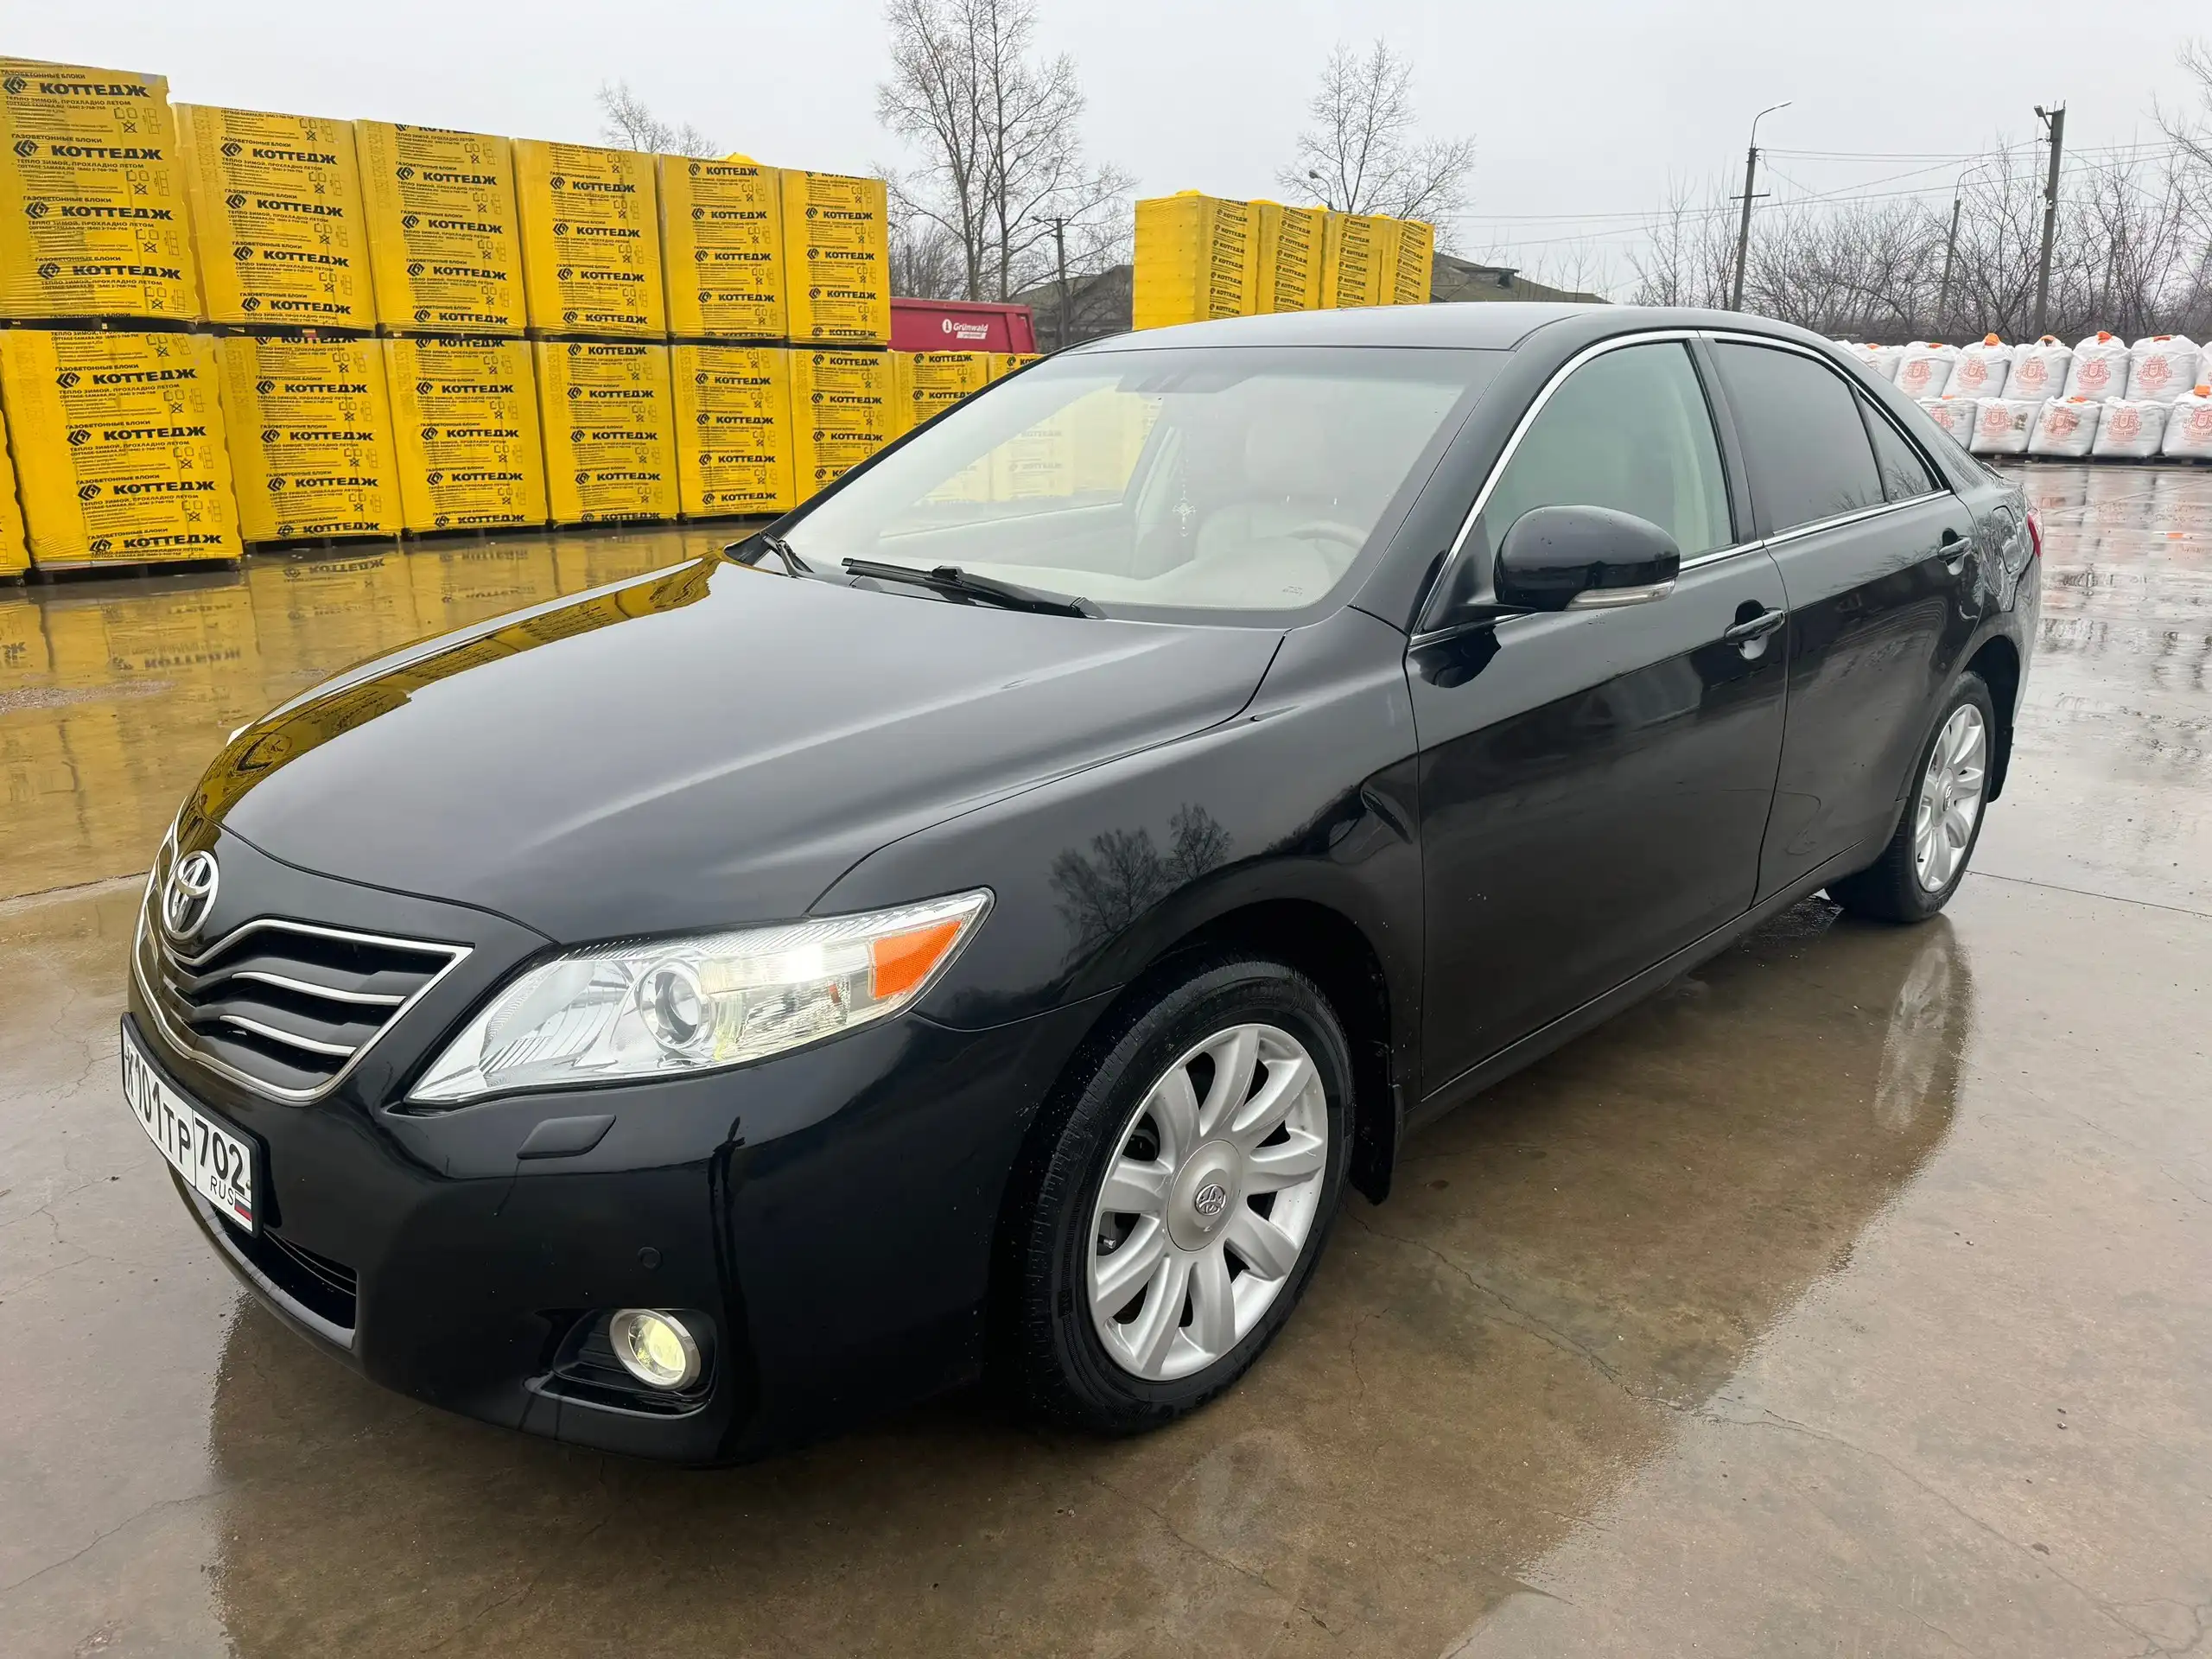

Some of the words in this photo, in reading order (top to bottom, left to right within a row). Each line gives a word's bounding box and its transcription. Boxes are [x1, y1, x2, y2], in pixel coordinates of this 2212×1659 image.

[40, 82, 150, 98] КОТТЕДЖ
[51, 144, 163, 161] КОТТЕДЖ
[252, 149, 338, 165] КОТТЕДЖ
[706, 166, 759, 176] КОТТЕДЖ
[423, 171, 497, 186] КОТТЕДЖ
[572, 181, 635, 193] КОТТЕДЖ
[61, 206, 174, 220] КОТТЕДЖ
[257, 199, 344, 218] КОТТЕДЖ
[711, 210, 767, 219] КОТТЕДЖ
[823, 211, 873, 220] КОТТЕДЖ
[428, 219, 503, 234] КОТТЕДЖ
[576, 226, 640, 238] КОТТЕДЖ
[263, 251, 349, 268] КОТТЕДЖ
[715, 251, 772, 261] КОТТЕДЖ
[825, 251, 874, 260] КОТТЕДЖ
[73, 266, 181, 280] КОТТЕДЖ
[433, 266, 506, 281] КОТТЕДЖ
[581, 270, 645, 282] КОТТЕДЖ
[718, 293, 775, 302] КОТТЕДЖ
[827, 290, 876, 300] КОТТЕДЖ
[270, 301, 351, 315] КОТТЕДЖ
[439, 312, 508, 325] КОТТЕДЖ
[585, 314, 648, 324] КОТТЕДЖ
[953, 322, 988, 332] Grünwald
[829, 328, 877, 338] КОТТЕДЖ
[588, 346, 647, 356] КОТТЕДЖ
[830, 357, 880, 366] КОТТЕДЖ
[929, 354, 973, 363] КОТТЕДЖ
[93, 368, 198, 385] КОТТЕДЖ
[714, 376, 771, 385] КОТТЕДЖ
[285, 384, 368, 393] КОТТЕДЖ
[442, 384, 514, 394] КОТТЕДЖ
[589, 389, 654, 399] КОТТЕДЖ
[830, 395, 882, 404] КОТТЕДЖ
[715, 416, 774, 425] КОТТЕДЖ
[104, 425, 207, 441] КОТТЕДЖ
[290, 431, 373, 442] КОТТЕДЖ
[446, 429, 518, 438] КОТТЕДЖ
[593, 430, 658, 441] КОТТЕДЖ
[830, 433, 883, 442] КОТТЕДЖ
[717, 454, 776, 464] КОТТЕДЖ
[452, 472, 524, 482] КОТТЕДЖ
[596, 472, 661, 482] КОТТЕДЖ
[113, 480, 216, 495] КОТТЕДЖ
[296, 477, 378, 488] КОТТЕДЖ
[721, 492, 777, 502] КОТТЕДЖ
[457, 514, 525, 524] КОТТЕДЖ
[601, 512, 660, 521] КОТТЕДЖ
[303, 522, 380, 533] КОТТЕДЖ
[124, 534, 223, 549] КОТТЕДЖ
[194, 1116, 245, 1197] 702
[211, 1175, 234, 1206] RUS
